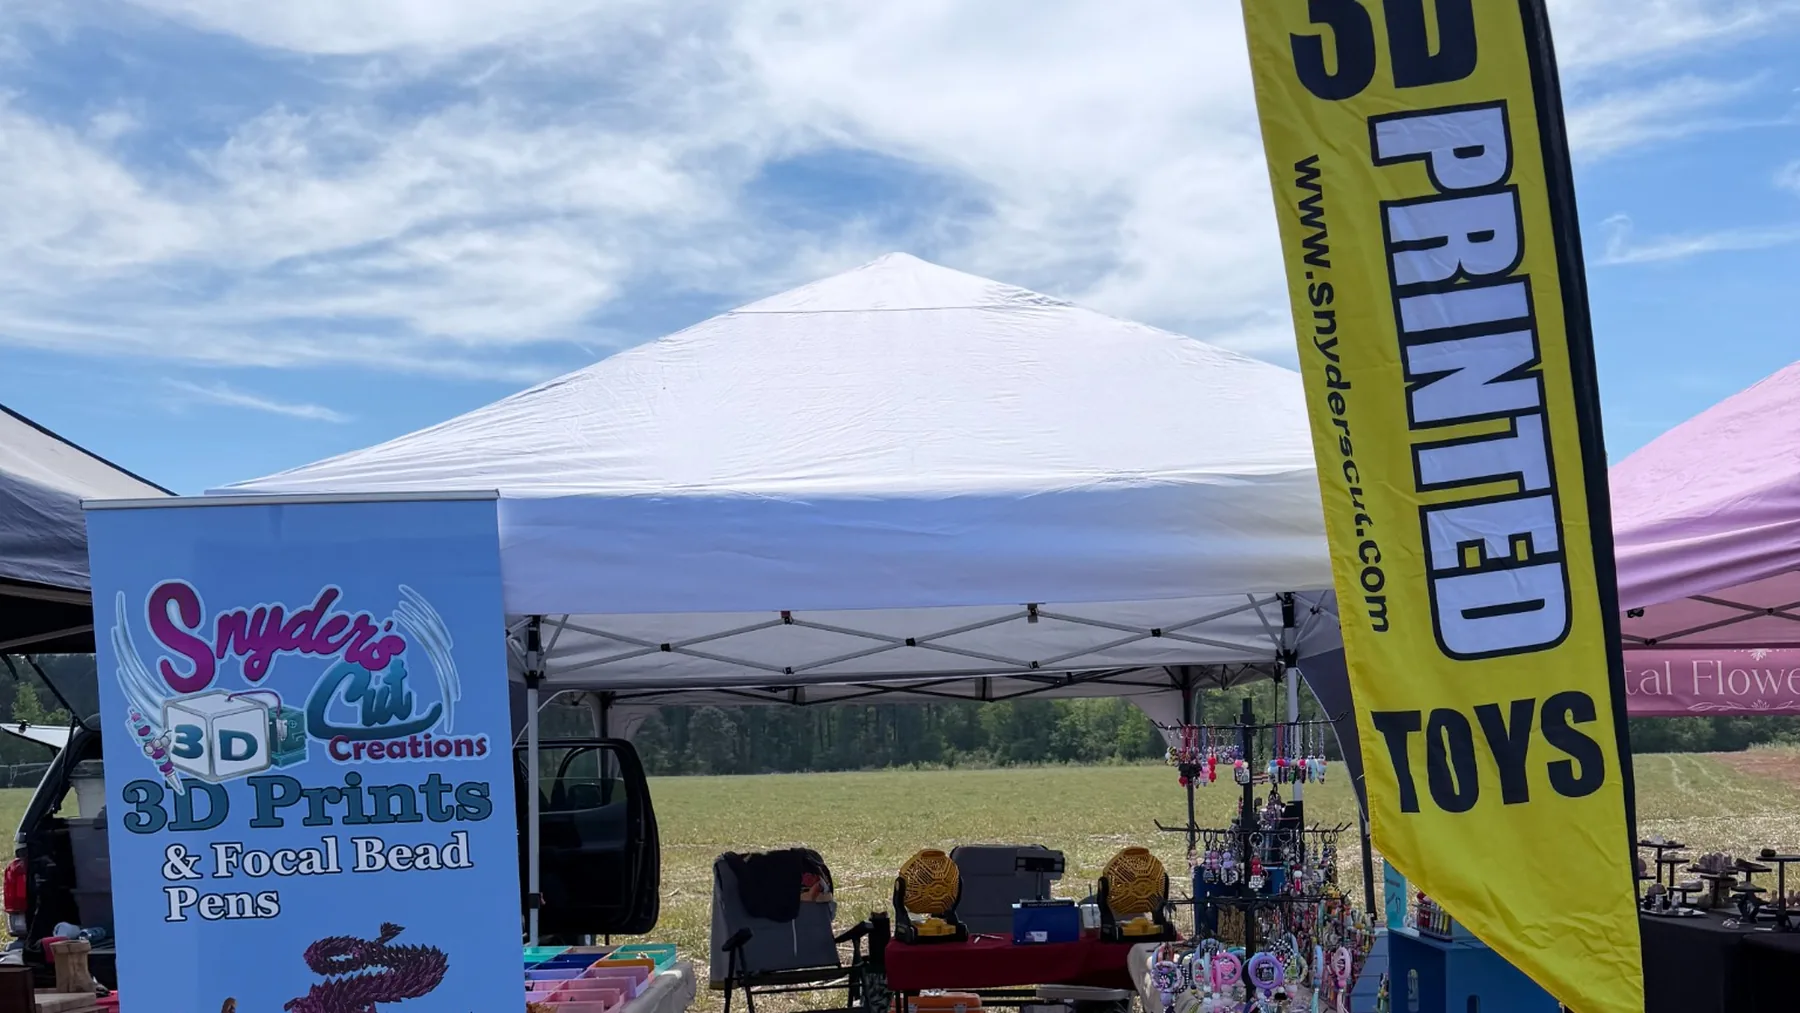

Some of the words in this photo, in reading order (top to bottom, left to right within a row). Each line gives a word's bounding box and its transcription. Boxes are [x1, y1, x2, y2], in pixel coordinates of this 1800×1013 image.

[1294, 154, 1389, 633] www.snyderscut.com
[1367, 99, 1572, 661] PRINTED
[148, 581, 406, 690] Snyder's
[306, 658, 443, 741] Cut
[329, 733, 487, 761] Creations
[1371, 690, 1606, 813] TOYS
[122, 777, 229, 834] 3D
[247, 771, 493, 828] Prints
[162, 843, 202, 880] &
[211, 836, 342, 878] Focal
[351, 831, 473, 873] Bead
[164, 885, 281, 921] Pens
